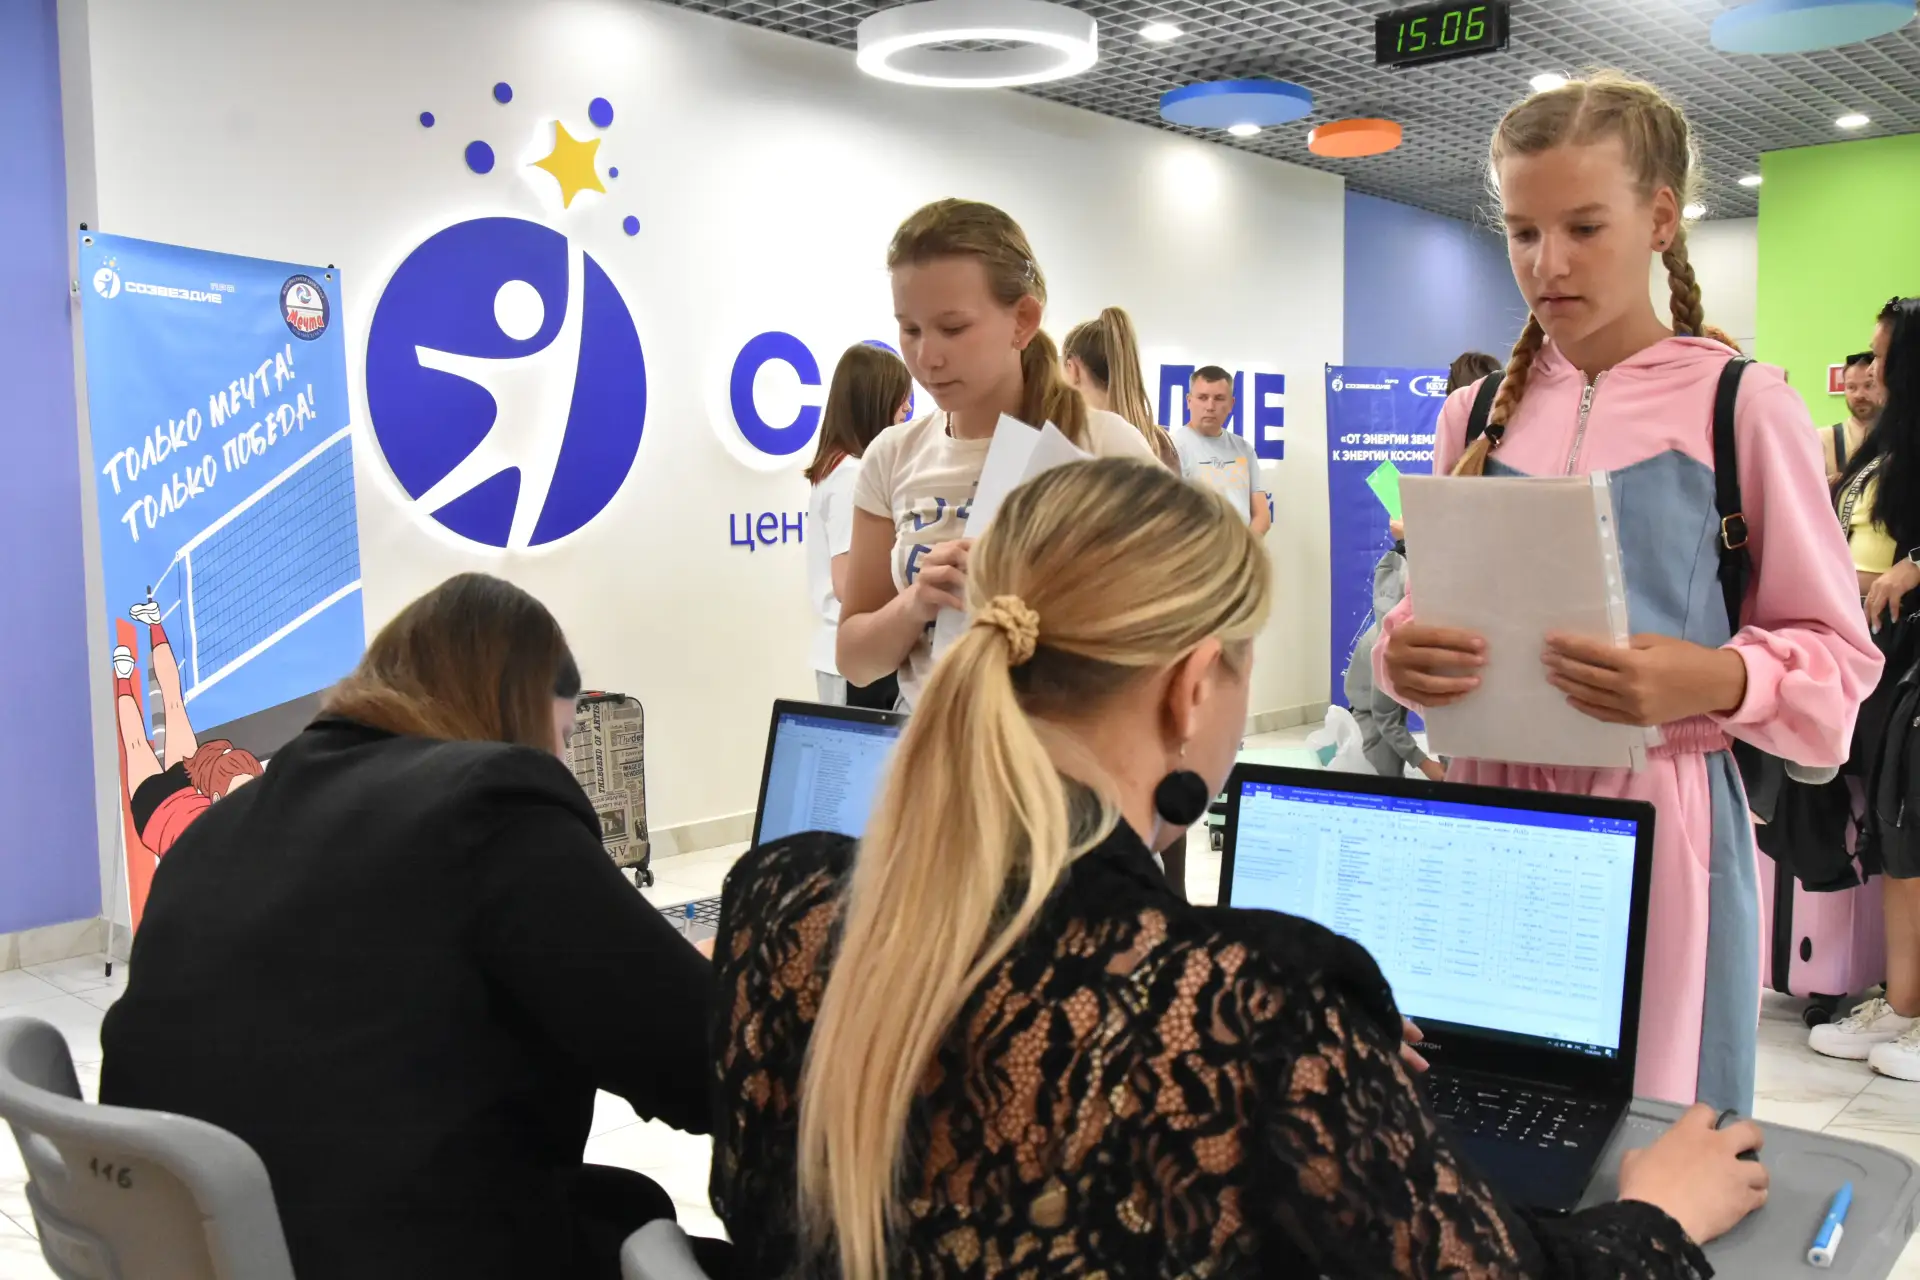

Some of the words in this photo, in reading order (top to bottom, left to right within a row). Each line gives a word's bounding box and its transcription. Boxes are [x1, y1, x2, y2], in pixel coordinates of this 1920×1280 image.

[124, 281, 222, 304] СОЗВЕЗДИЕ
[287, 310, 325, 332] Мечта
[102, 408, 202, 495] ТОЛЬКО
[209, 343, 295, 428] МЕЧТА!
[1340, 434, 1361, 445] «ОТ
[1363, 434, 1409, 445] ЭНЕРГИИ
[121, 454, 217, 543] ТОЛЬКО
[222, 383, 317, 473] ПОБЕДА!
[1333, 450, 1340, 461] К
[1342, 450, 1389, 461] ЭНЕРГИИ
[730, 511, 809, 552] цен
[592, 701, 601, 732] ARTIS
[89, 1156, 133, 1190] 116
